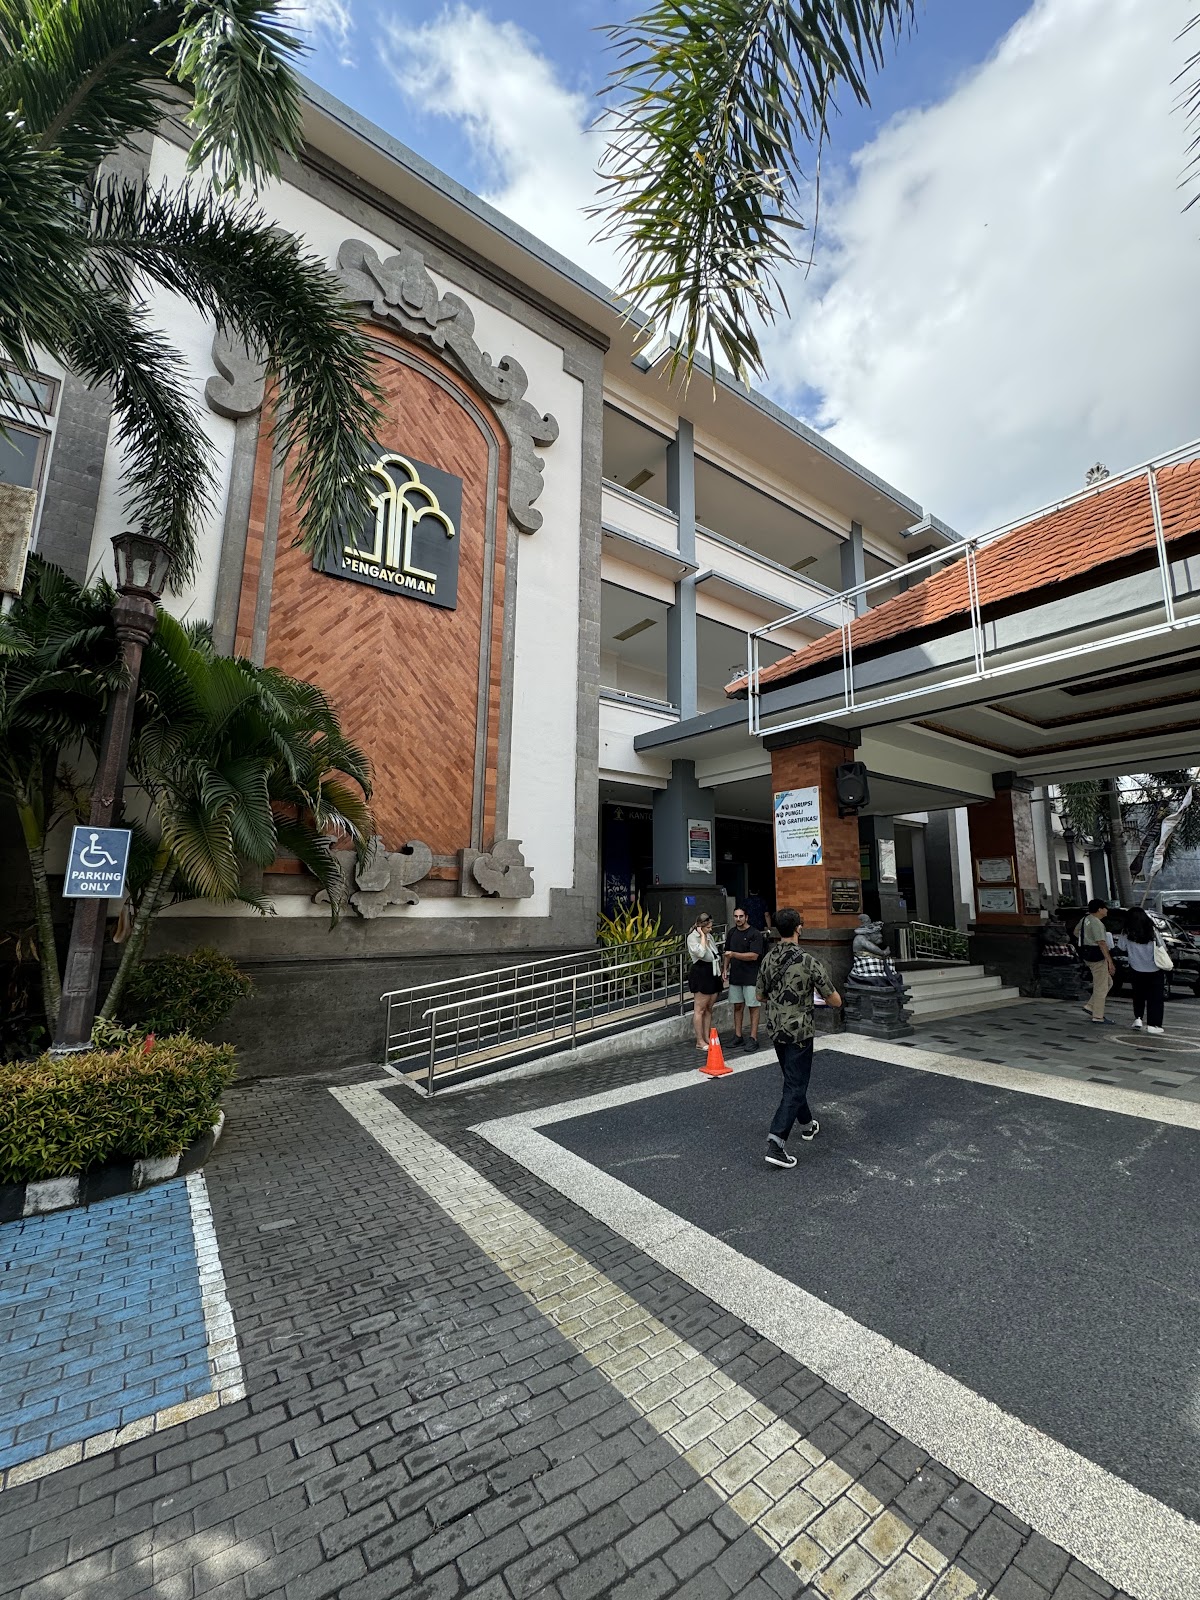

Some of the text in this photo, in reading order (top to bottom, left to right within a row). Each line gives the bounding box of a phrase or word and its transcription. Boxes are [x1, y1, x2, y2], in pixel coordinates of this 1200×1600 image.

[341, 556, 437, 595] PENGAYOMAN
[787, 816, 818, 824] GRATIFIKASI
[71, 871, 121, 881] PARKING
[80, 882, 110, 891] ONLY
